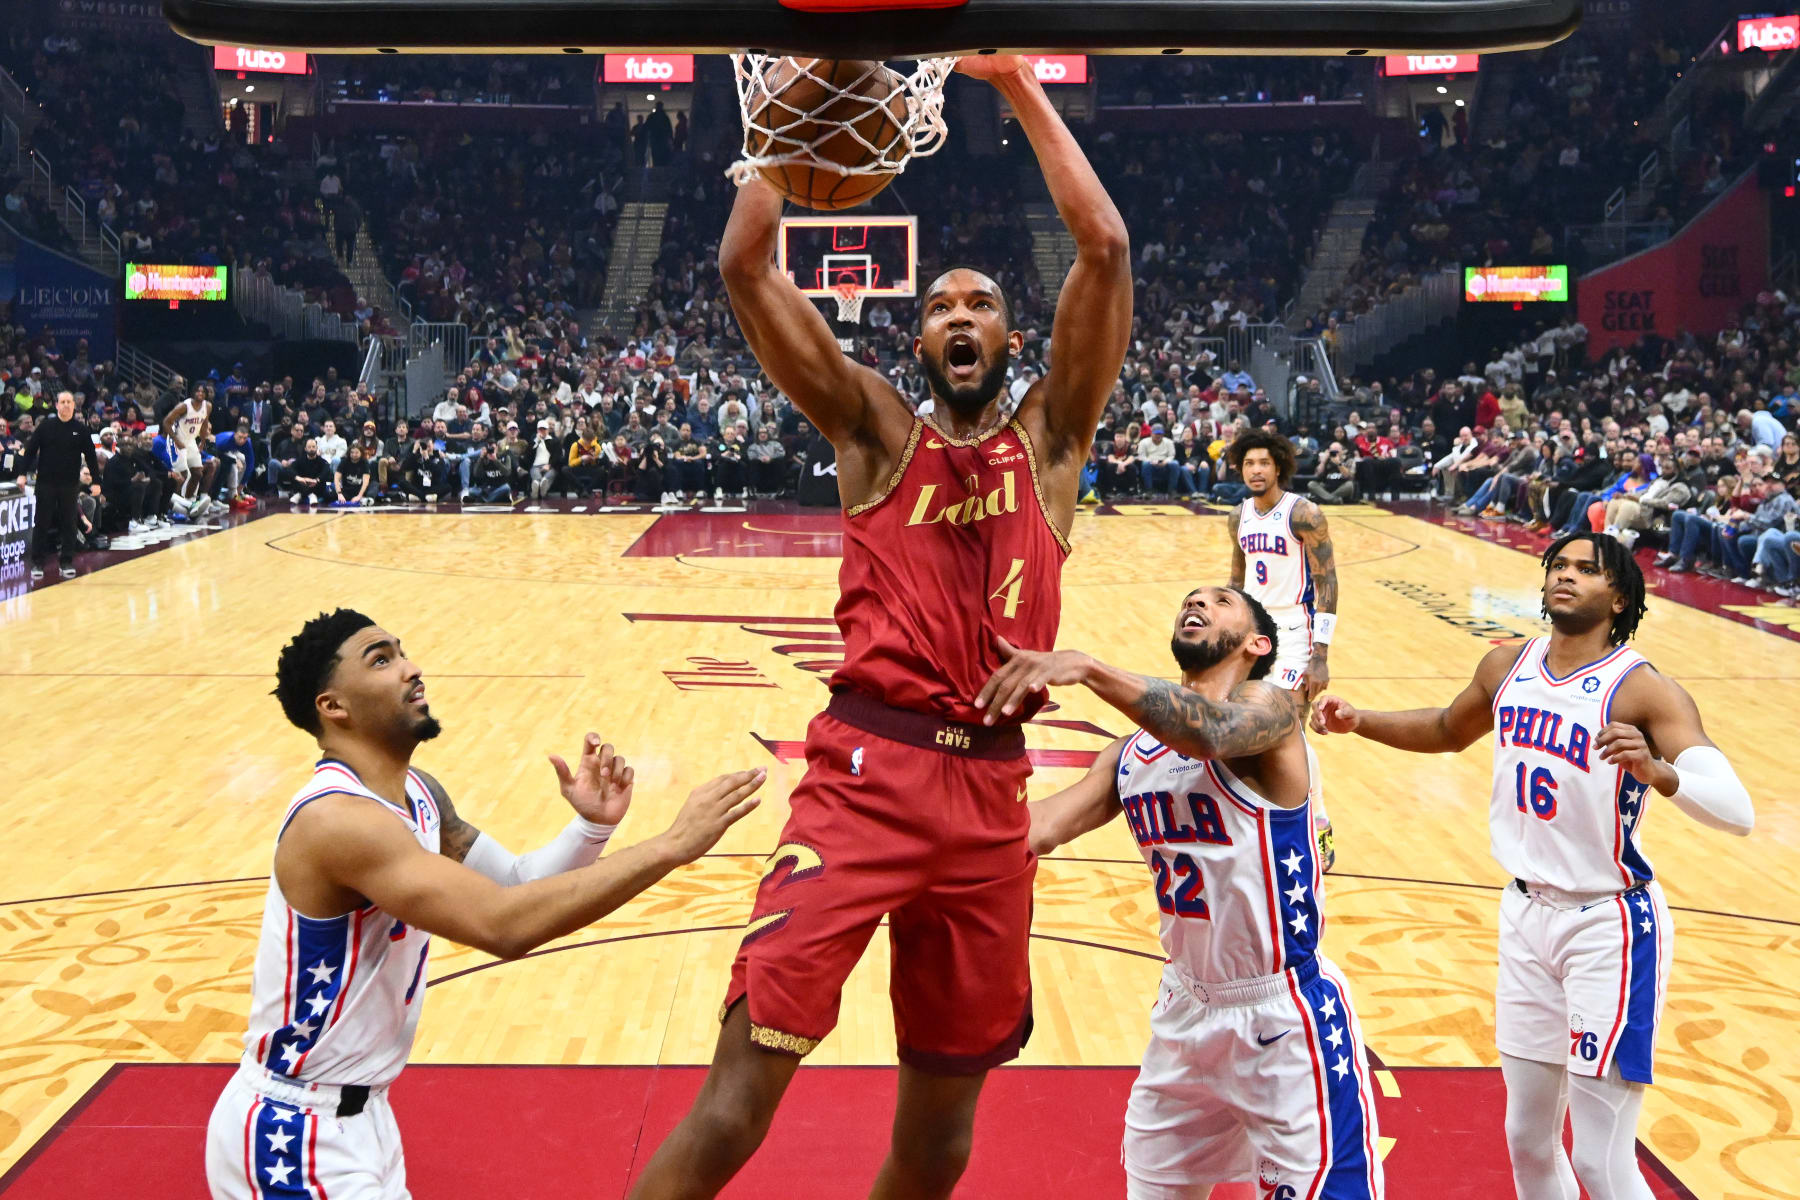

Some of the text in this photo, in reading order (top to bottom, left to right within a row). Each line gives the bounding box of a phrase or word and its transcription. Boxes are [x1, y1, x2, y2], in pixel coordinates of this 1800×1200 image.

[1742, 22, 1796, 48] fubo
[236, 47, 286, 70] fubo
[625, 57, 673, 79] fubo
[147, 271, 222, 295] Huntington
[1604, 290, 1656, 311] SEAT
[1602, 311, 1656, 332] GEEK
[988, 452, 1025, 466] CLIFFS
[904, 470, 1020, 527] Land
[1240, 532, 1289, 557] PHILA
[1255, 560, 1269, 586] 9
[989, 557, 1025, 620] 4
[1281, 667, 1298, 684] 76
[935, 730, 971, 750] CAVS
[1498, 705, 1592, 774] PHILA
[1168, 761, 1203, 774] crypto.com
[1515, 761, 1559, 822] 16
[1122, 790, 1234, 848] HILA
[1151, 849, 1211, 921] 22
[1570, 1028, 1598, 1062] 76
